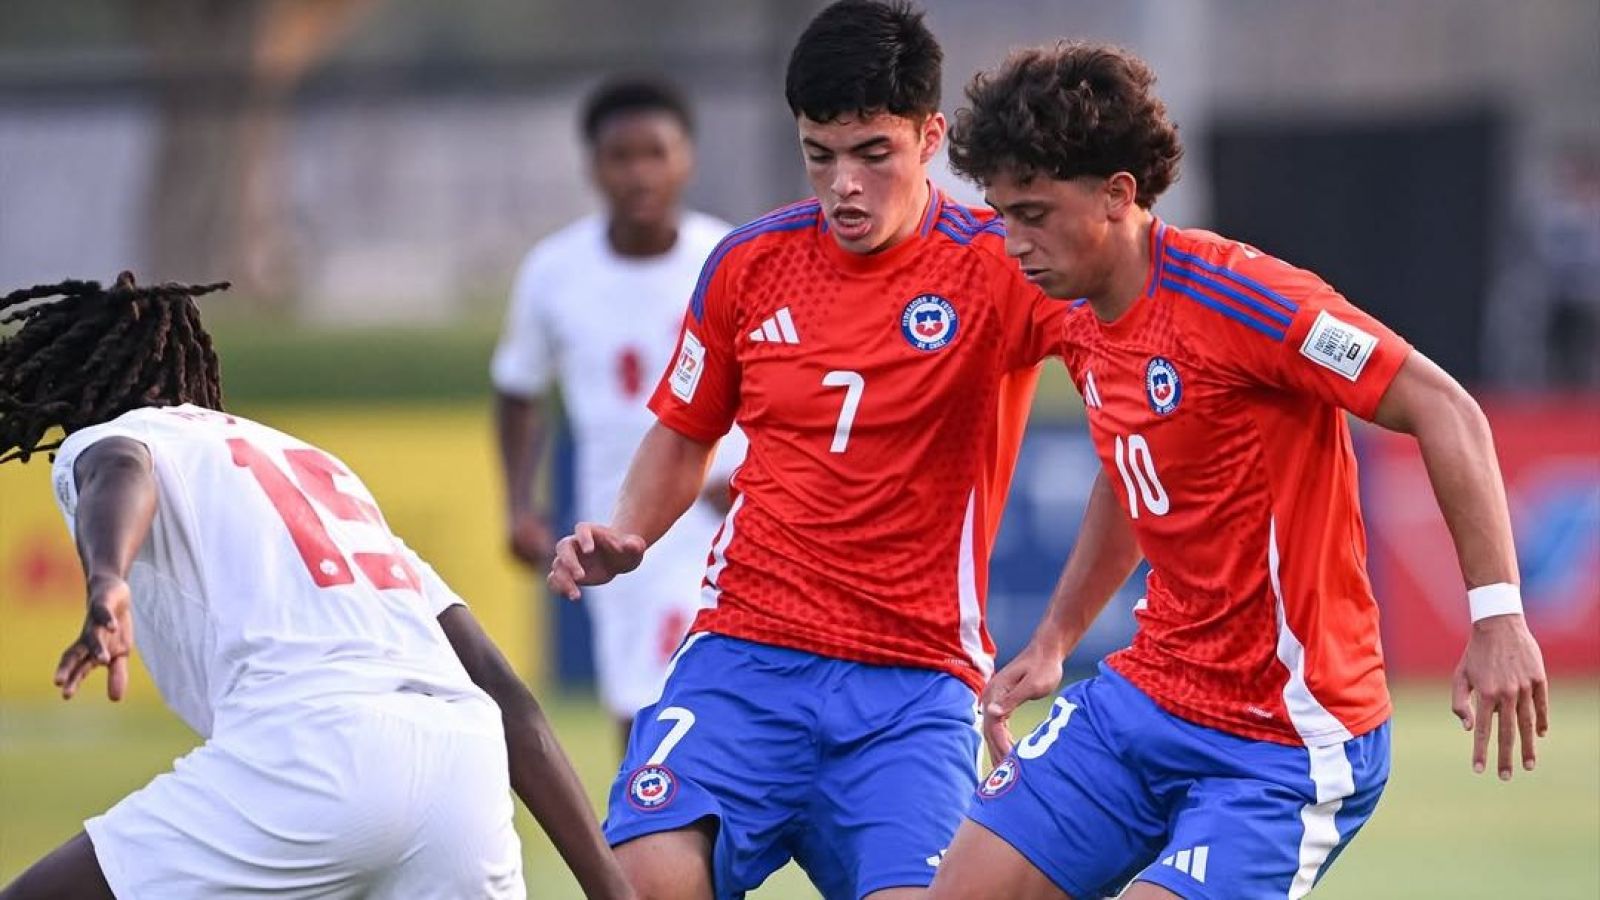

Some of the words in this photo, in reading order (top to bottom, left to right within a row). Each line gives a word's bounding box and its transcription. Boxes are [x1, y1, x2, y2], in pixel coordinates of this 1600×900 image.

[821, 370, 865, 453] 7
[225, 437, 421, 591] 15
[1115, 433, 1170, 520] 10
[646, 706, 696, 766] 7
